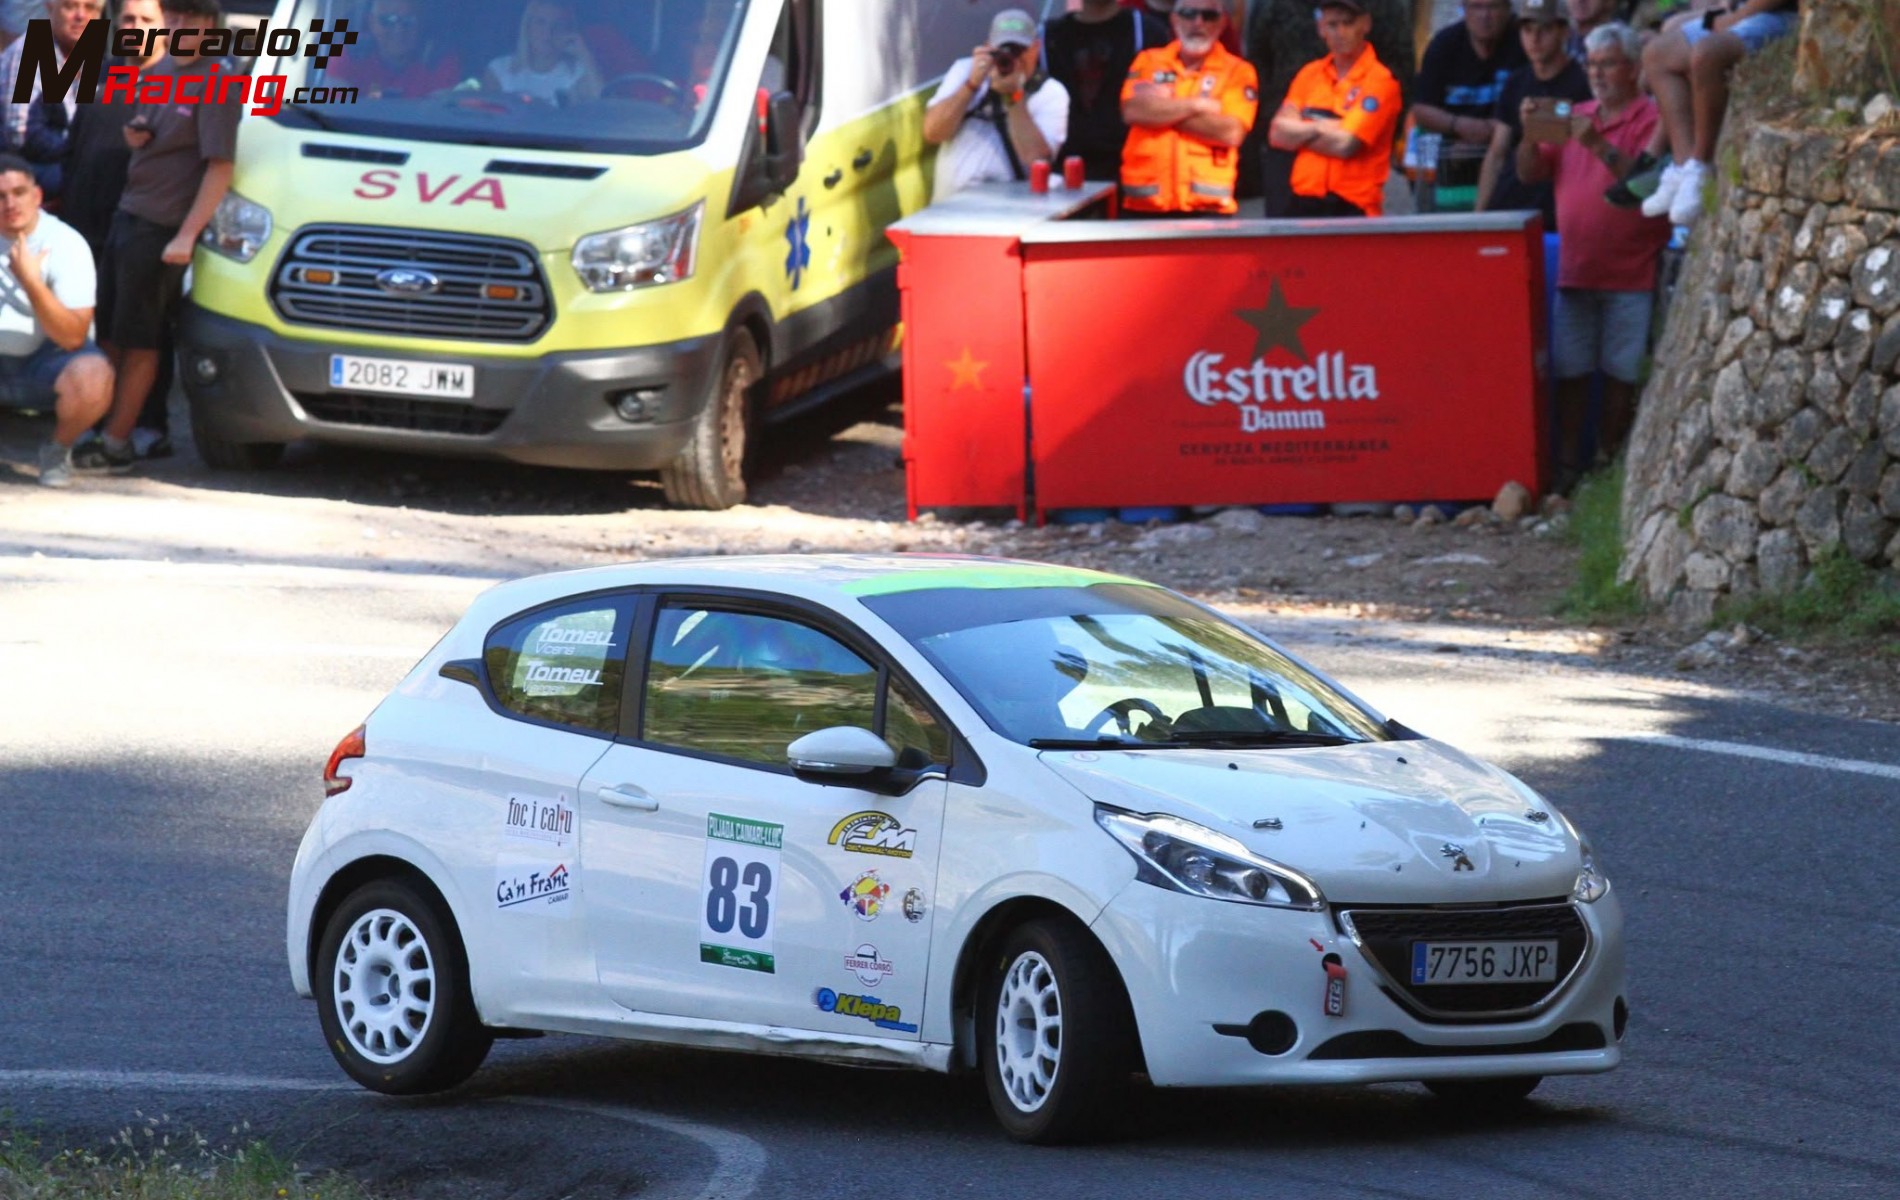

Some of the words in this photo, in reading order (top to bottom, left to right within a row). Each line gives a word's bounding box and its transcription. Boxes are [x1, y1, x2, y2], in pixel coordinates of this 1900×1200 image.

[353, 169, 507, 210] SVA
[349, 362, 408, 388] 2082
[420, 367, 466, 392] JWM
[1183, 349, 1380, 406] Estrella
[1240, 405, 1326, 433] Damm
[538, 622, 614, 644] Tomeu
[524, 660, 601, 683] Tomeu
[506, 797, 528, 827] foc
[531, 800, 538, 829] i
[706, 856, 772, 939] 83
[1429, 946, 1496, 978] 7756
[1503, 945, 1549, 978] JXP
[834, 993, 901, 1023] Klepa
